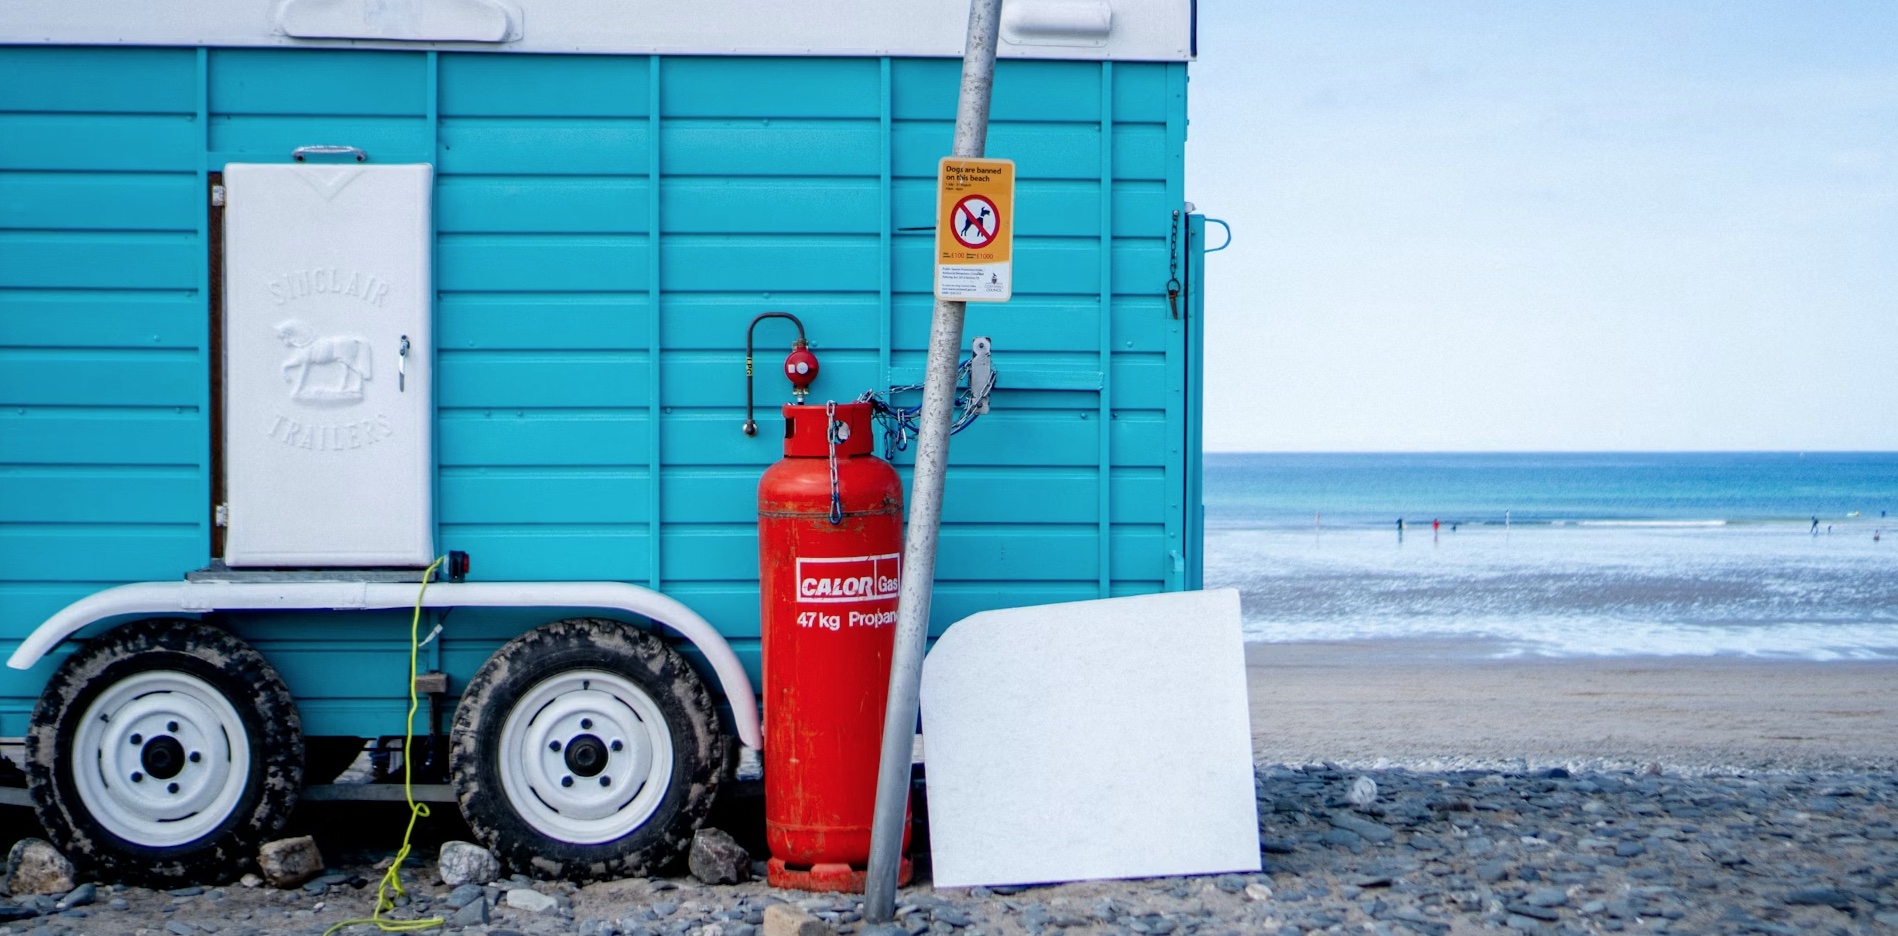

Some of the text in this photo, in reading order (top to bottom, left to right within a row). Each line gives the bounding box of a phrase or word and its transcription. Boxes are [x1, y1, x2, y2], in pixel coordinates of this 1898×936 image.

[946, 165, 963, 174] Dogs
[976, 166, 1002, 175] banned
[270, 268, 389, 308] SINCLAIR
[267, 414, 393, 451] TRAILERS
[801, 575, 898, 597] CALOR Gas
[848, 610, 899, 629] Propan
